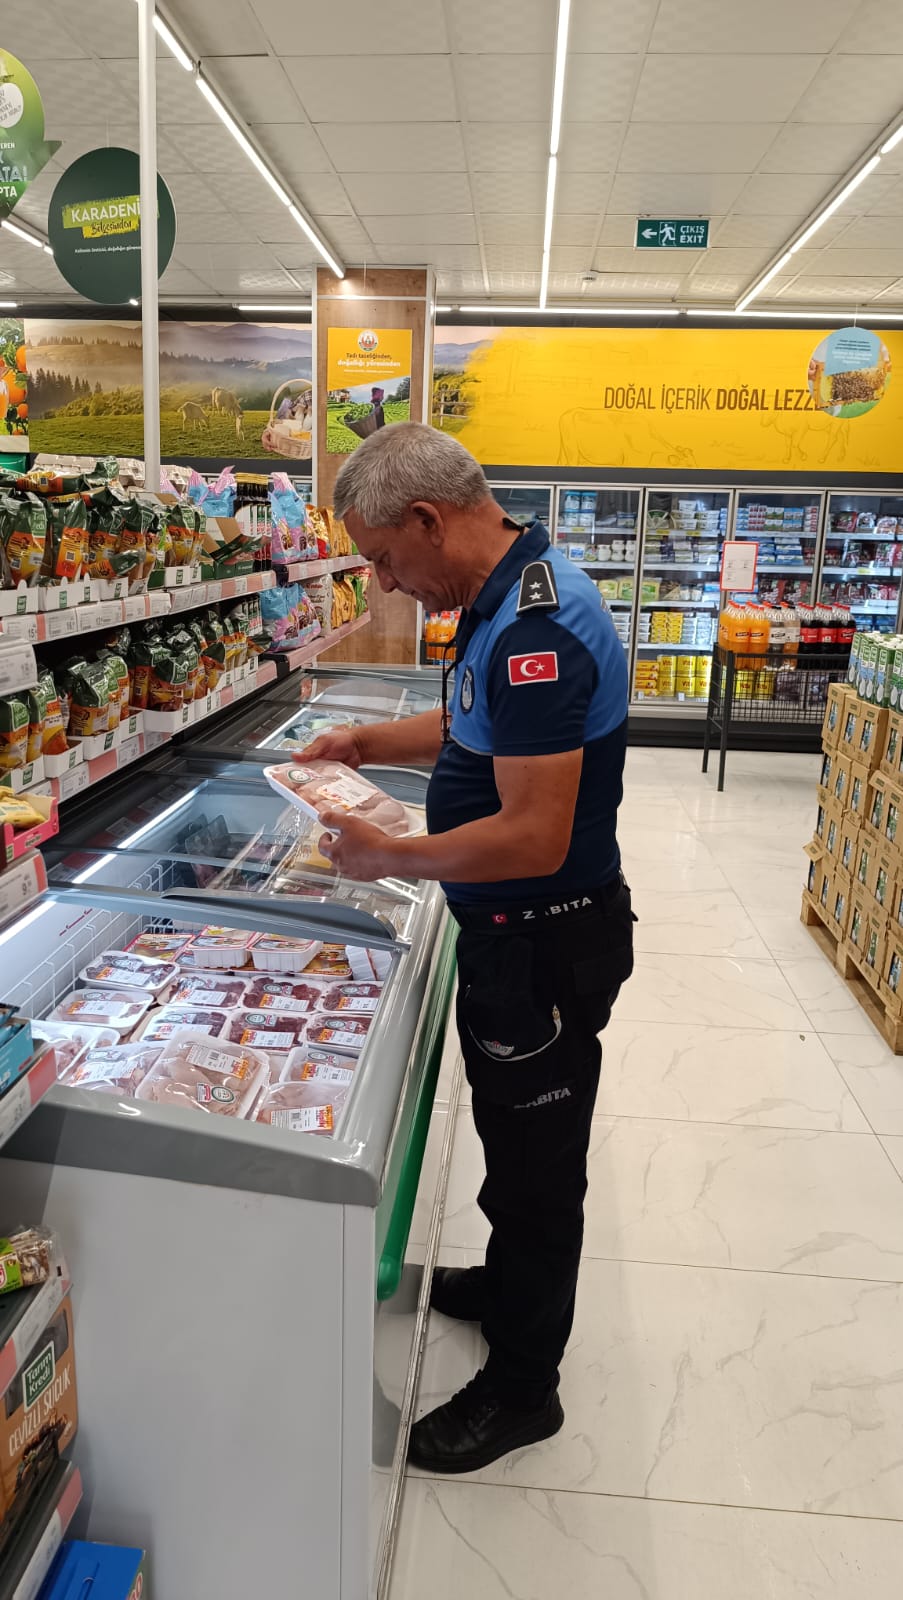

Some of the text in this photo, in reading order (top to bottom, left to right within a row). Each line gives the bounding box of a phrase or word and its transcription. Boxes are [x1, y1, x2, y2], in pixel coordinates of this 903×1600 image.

[679, 235, 704, 244] EXIT
[680, 225, 705, 236] ÇIKIŞ
[604, 383, 657, 410] DOĞAL
[660, 384, 712, 414] İÇERİK
[715, 384, 769, 411] DOĞAL
[522, 896, 593, 920] ZBITA
[26, 1353, 52, 1384] Tarım
[28, 1365, 51, 1397] Kredi
[43, 1364, 71, 1415] SUCUK
